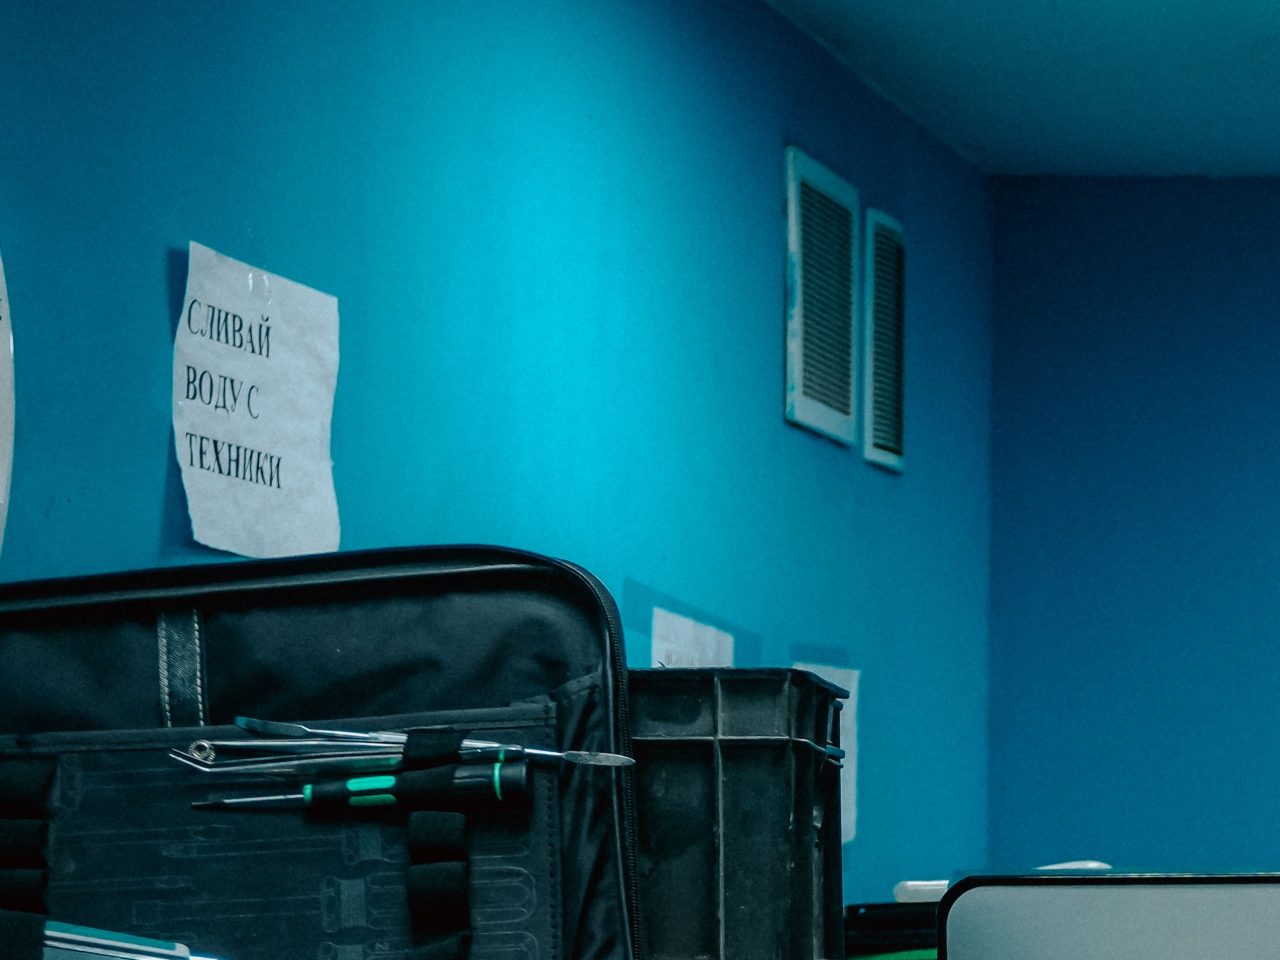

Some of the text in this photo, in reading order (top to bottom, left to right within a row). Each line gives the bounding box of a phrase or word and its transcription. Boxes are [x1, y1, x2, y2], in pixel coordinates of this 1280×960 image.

[187, 299, 272, 359] СЛИВАЙ
[185, 365, 260, 419] ВОДУ С
[185, 432, 283, 489] ТЕХНИКИ
